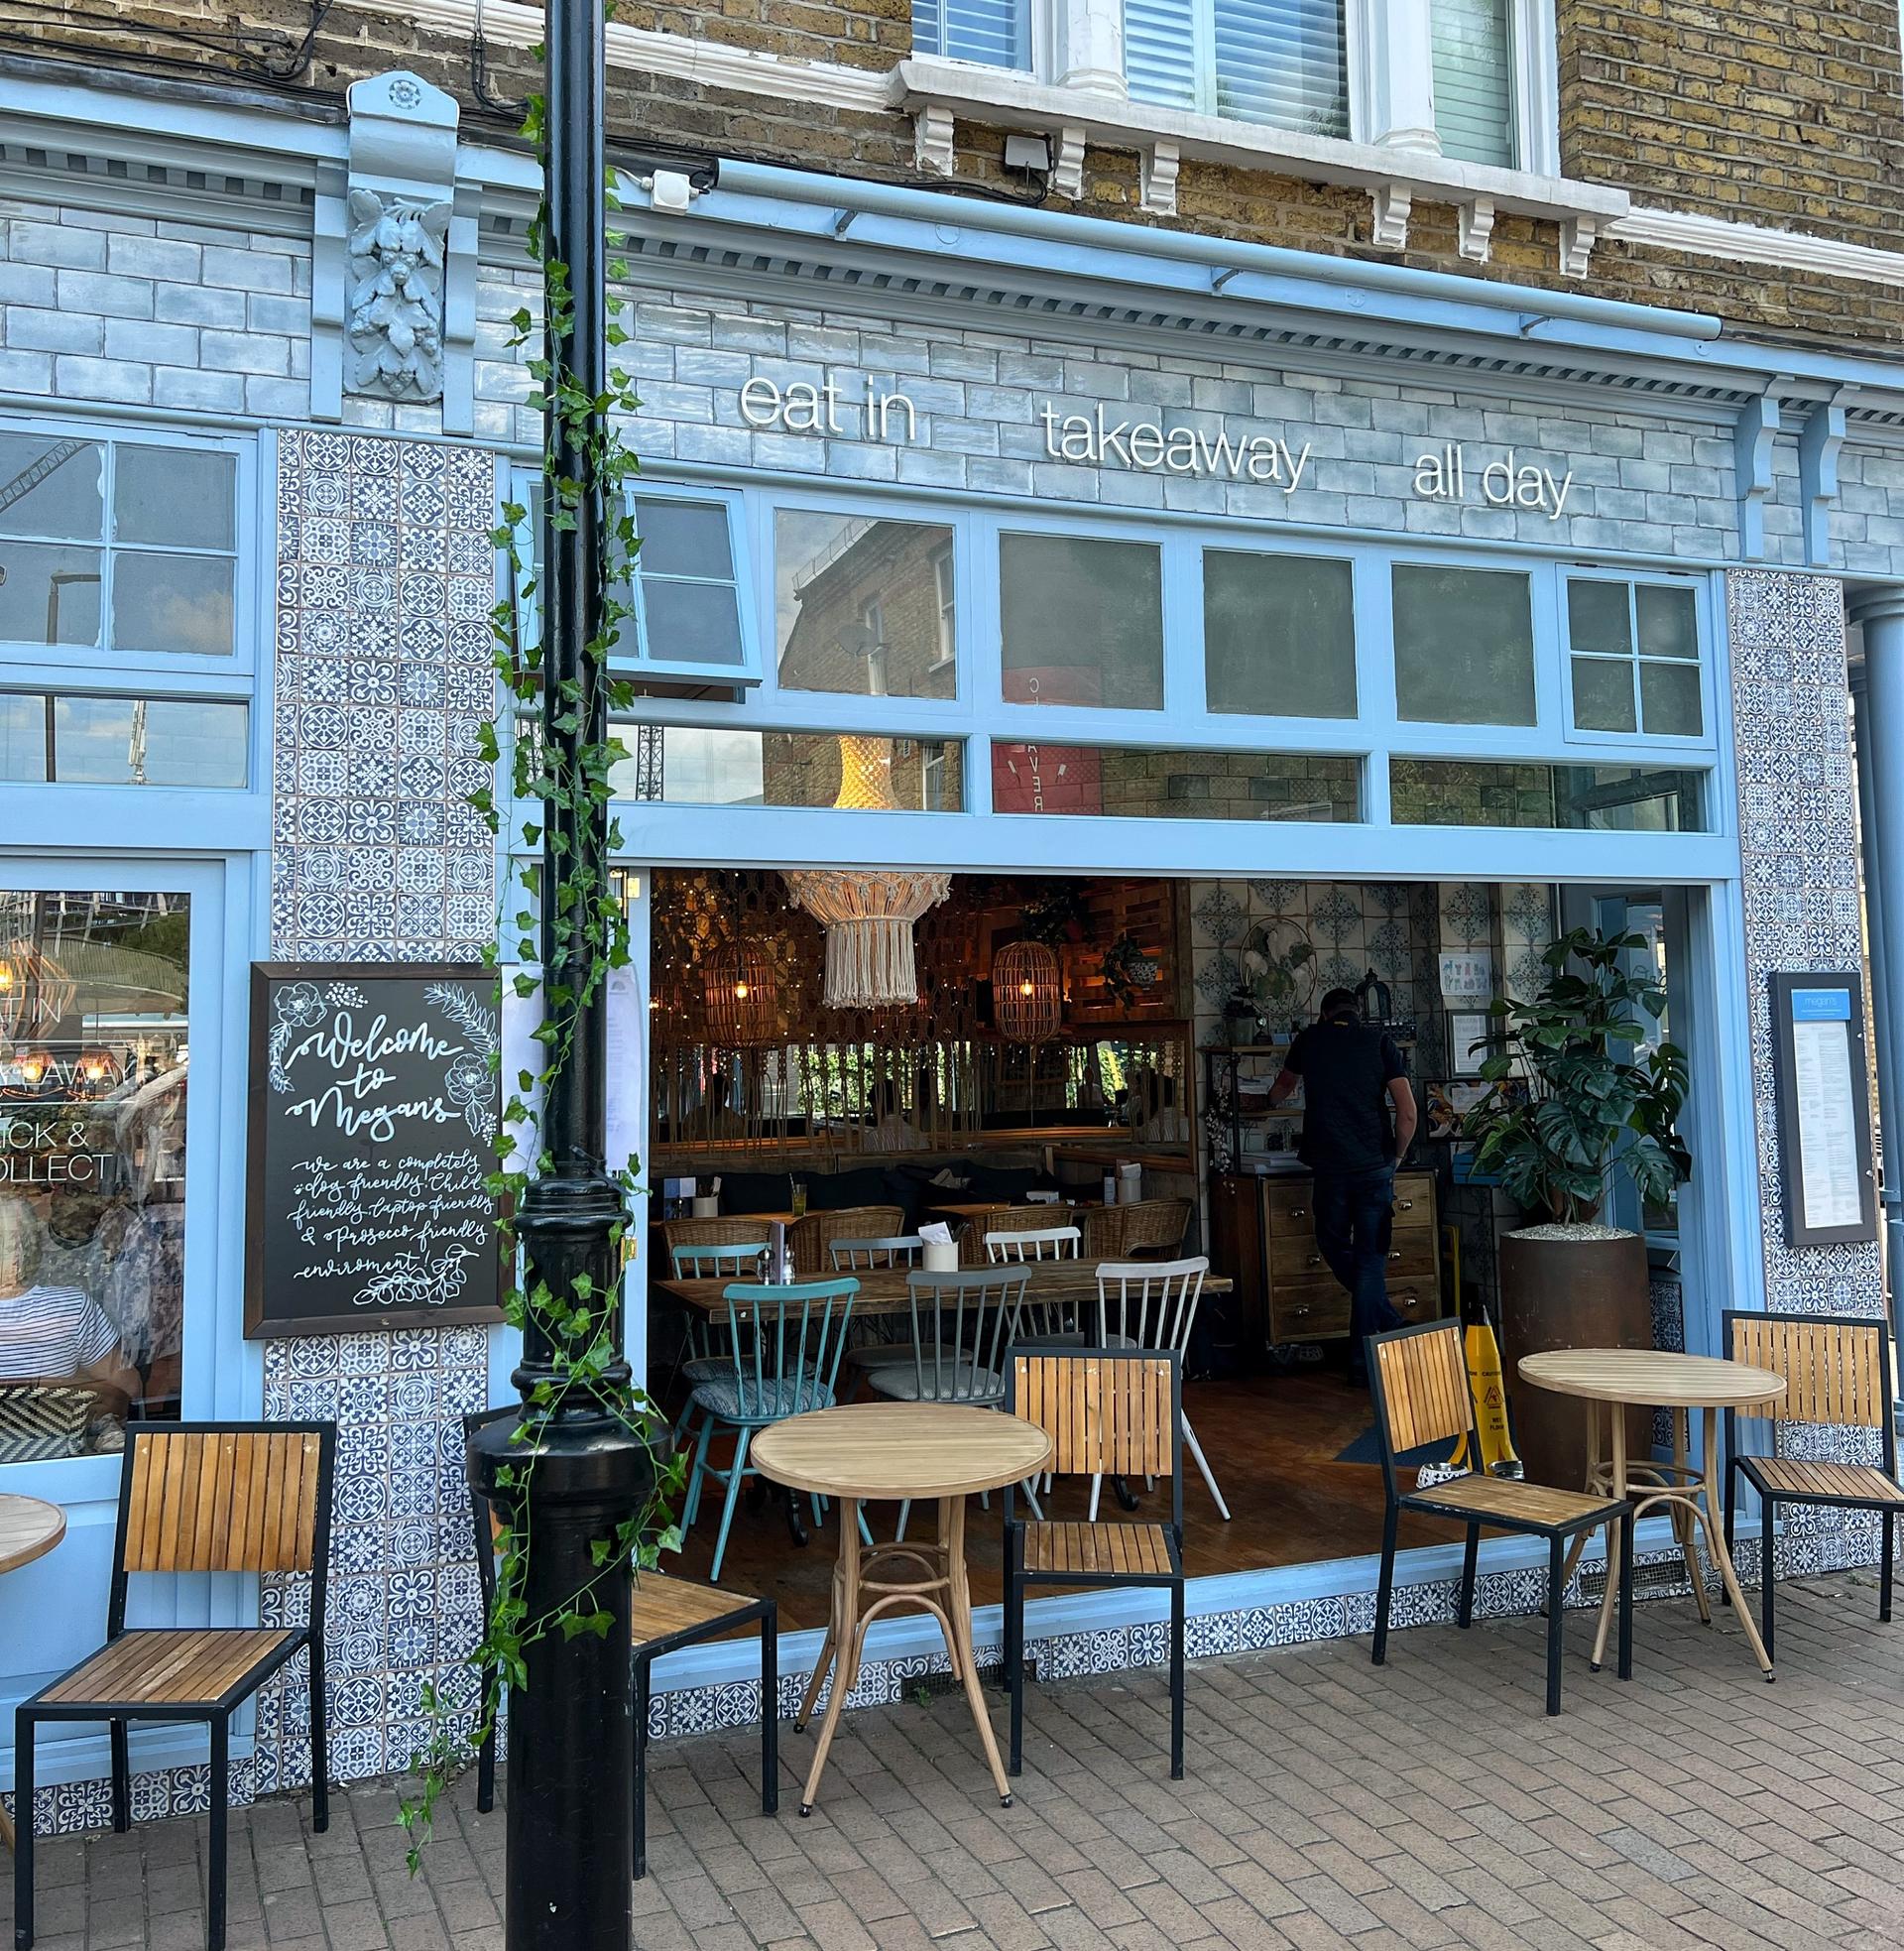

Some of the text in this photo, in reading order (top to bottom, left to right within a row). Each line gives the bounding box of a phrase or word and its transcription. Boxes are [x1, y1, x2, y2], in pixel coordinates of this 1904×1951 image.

[741, 374, 915, 440] eat in
[1040, 401, 1311, 494] takeaway
[1414, 444, 1573, 521] all day
[32, 998, 61, 1024] IN
[285, 1011, 464, 1069] Welcome
[335, 1062, 397, 1099] to
[285, 1086, 462, 1142] Megan's
[0, 1122, 89, 1149] ICK &
[342, 1158, 371, 1170] are
[377, 1158, 392, 1168] a
[398, 1149, 481, 1179] completely
[304, 1172, 345, 1202] dog
[369, 1196, 427, 1224] laptop
[428, 1194, 495, 1220] friendly
[300, 1226, 315, 1246] &
[410, 1219, 489, 1252] friendly
